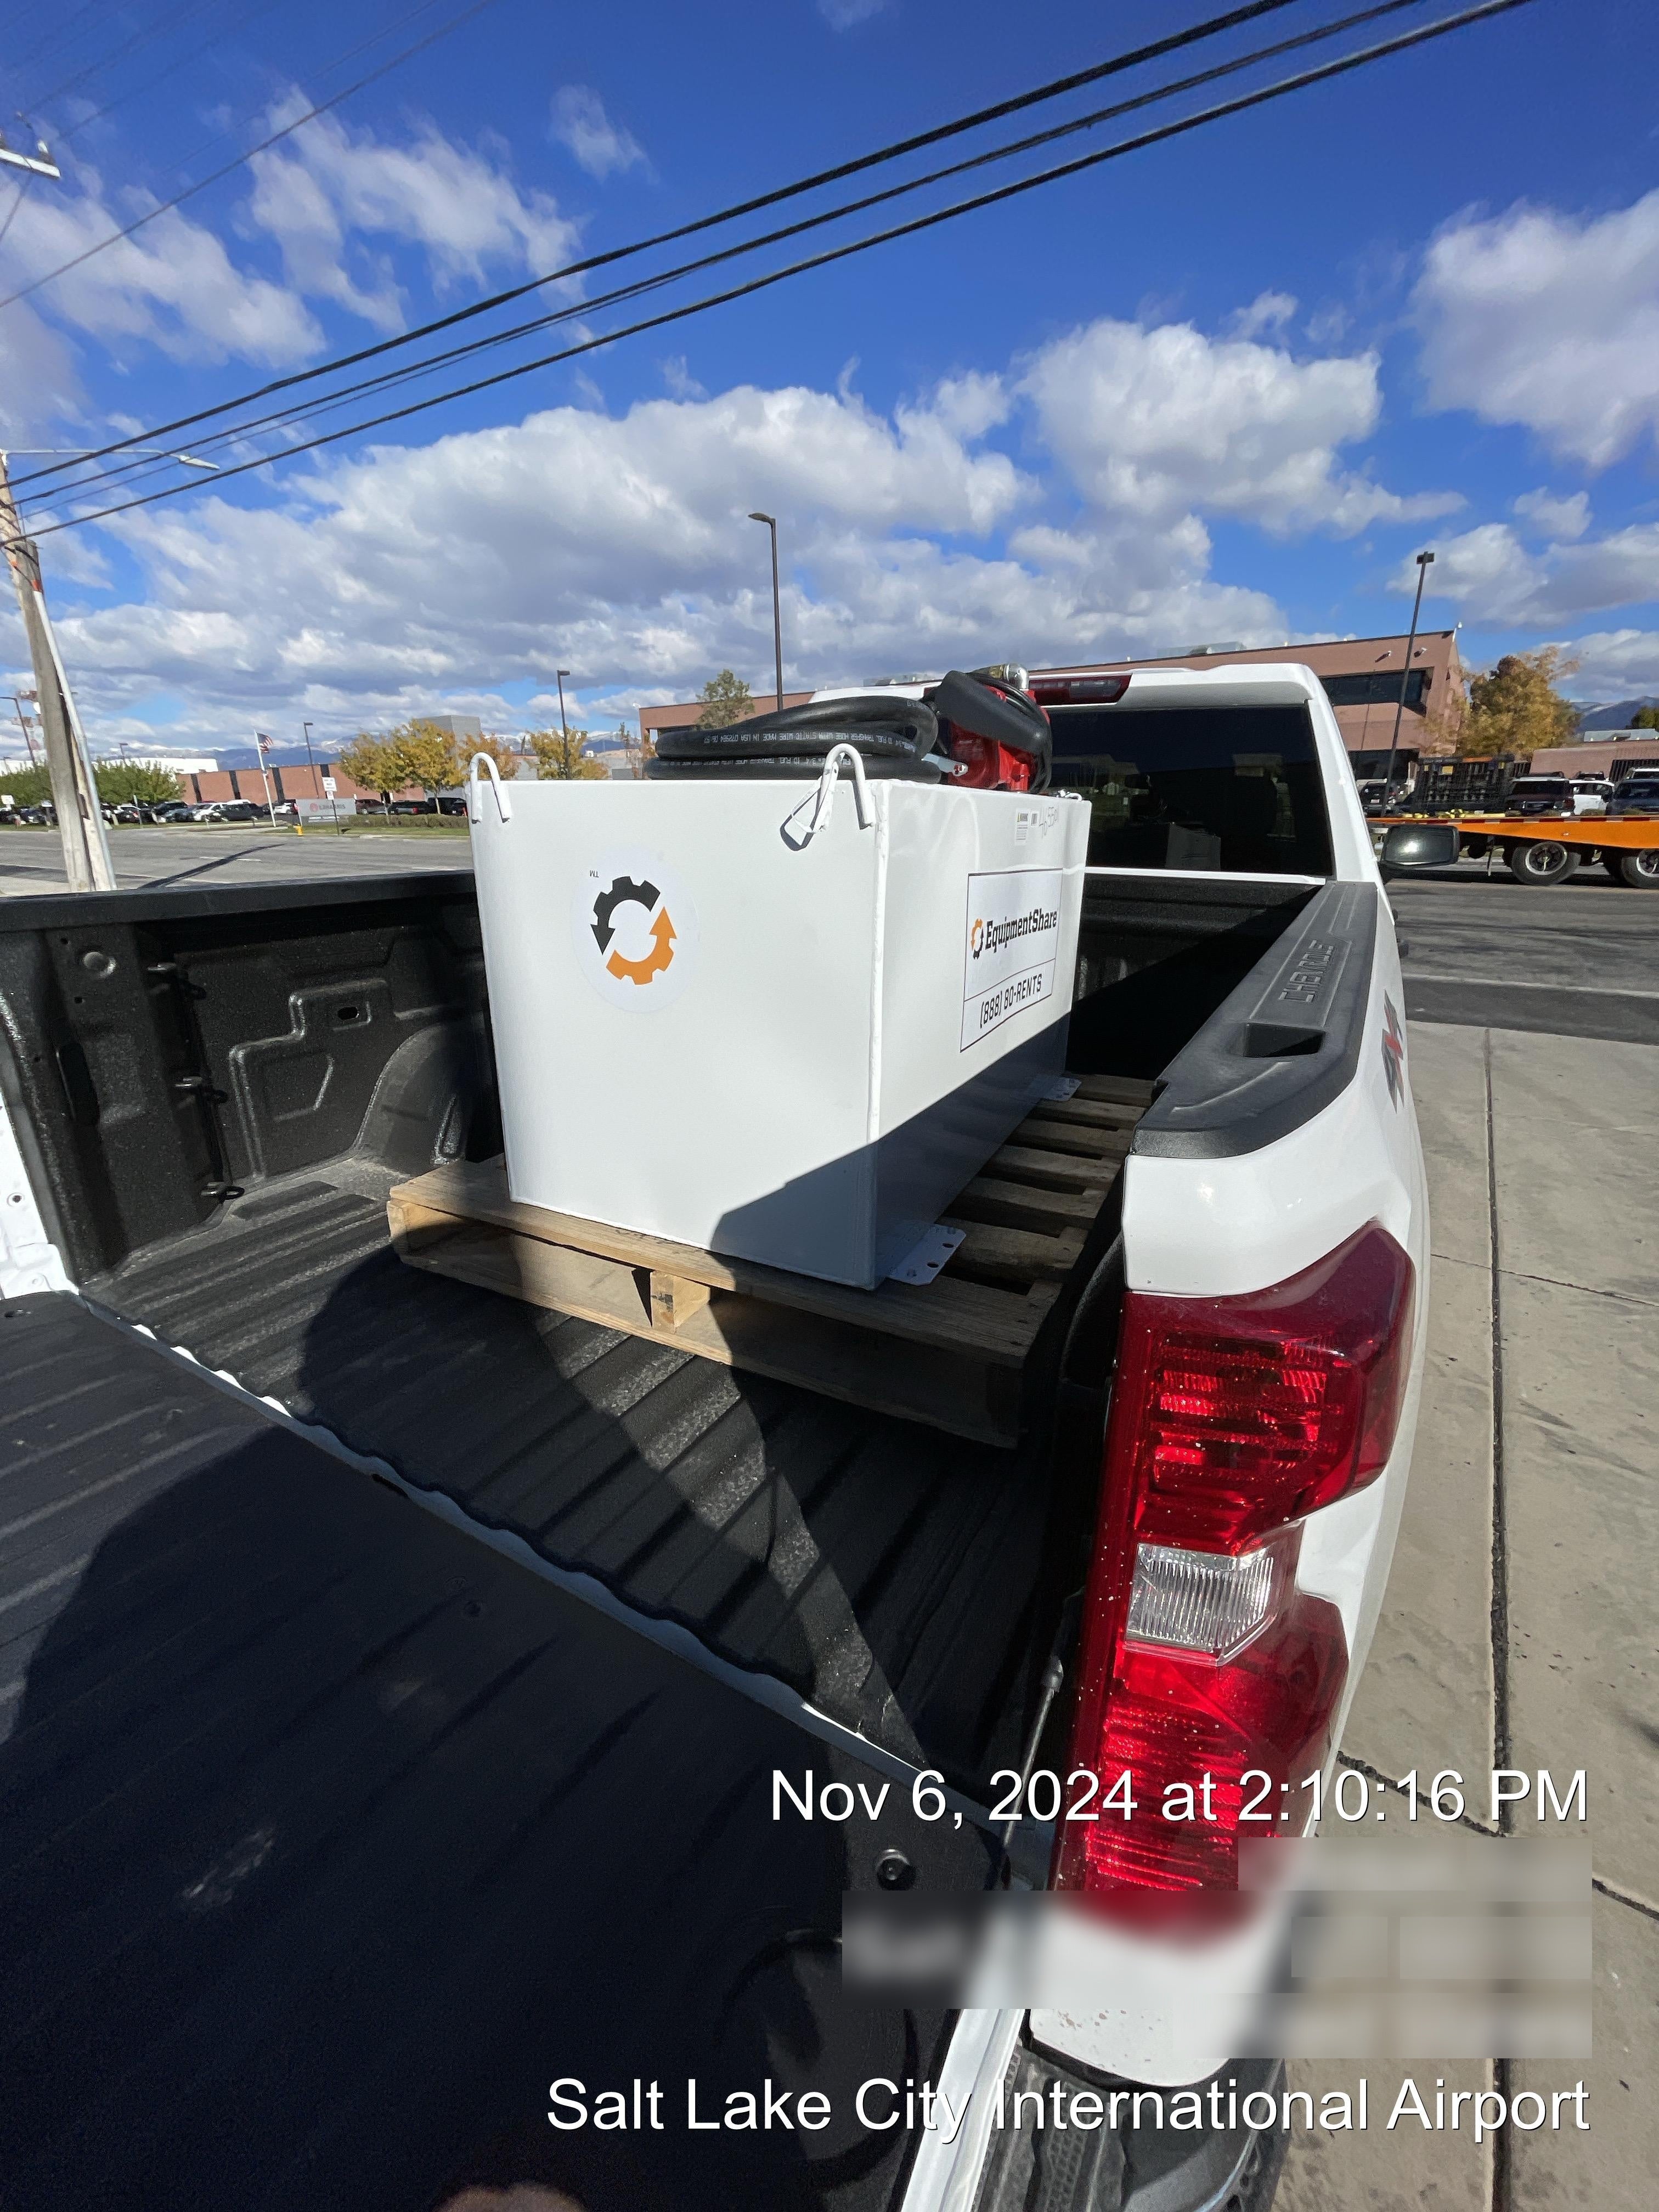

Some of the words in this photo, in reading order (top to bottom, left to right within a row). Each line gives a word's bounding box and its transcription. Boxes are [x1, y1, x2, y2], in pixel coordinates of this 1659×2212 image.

[753, 733, 760, 742] IN
[763, 733, 777, 741] MADE
[795, 732, 817, 740] STATIC
[985, 908, 1057, 953] EquipmentShare
[980, 990, 1003, 1029] (888)
[1004, 973, 1042, 1010] 80-RENTS
